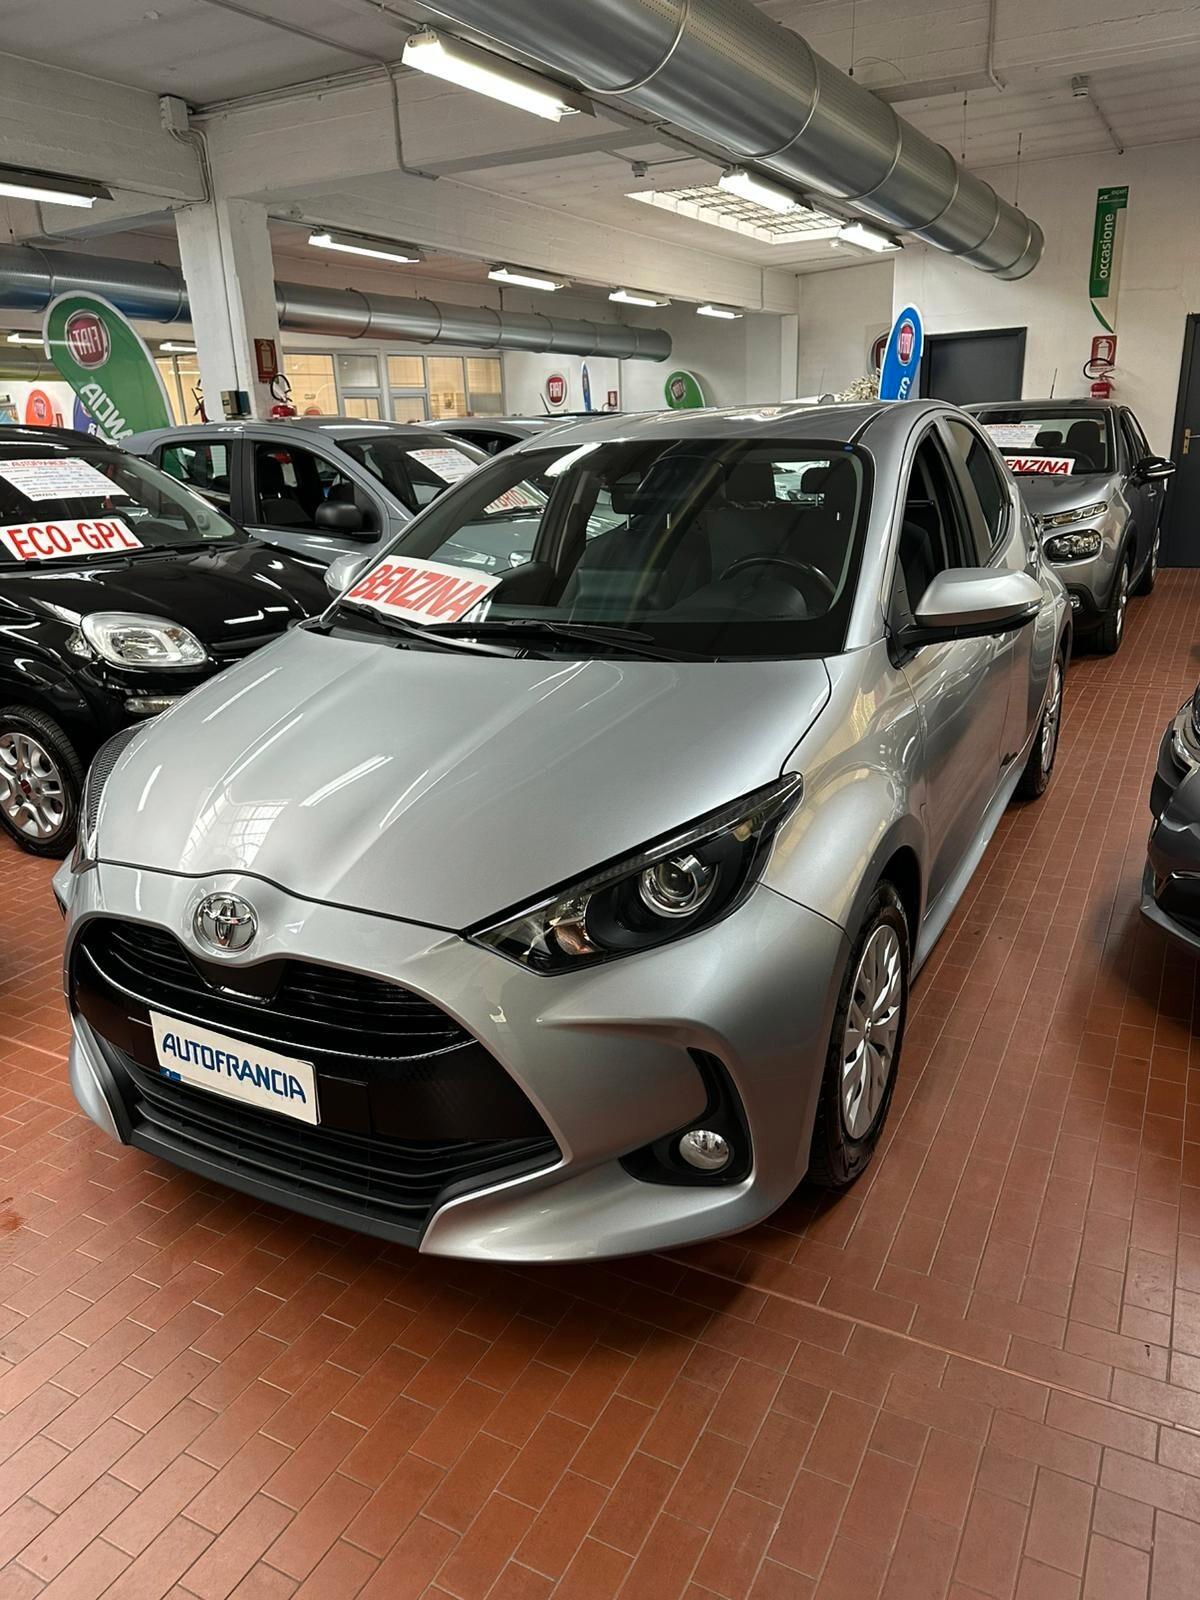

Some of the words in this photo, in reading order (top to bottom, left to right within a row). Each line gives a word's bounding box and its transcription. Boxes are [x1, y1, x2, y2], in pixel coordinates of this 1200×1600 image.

[1099, 213, 1114, 279] occasione
[7, 521, 138, 559] ECO-GPL
[347, 564, 488, 621] BENZINA
[162, 1032, 307, 1104] AUTOFRANCIA
